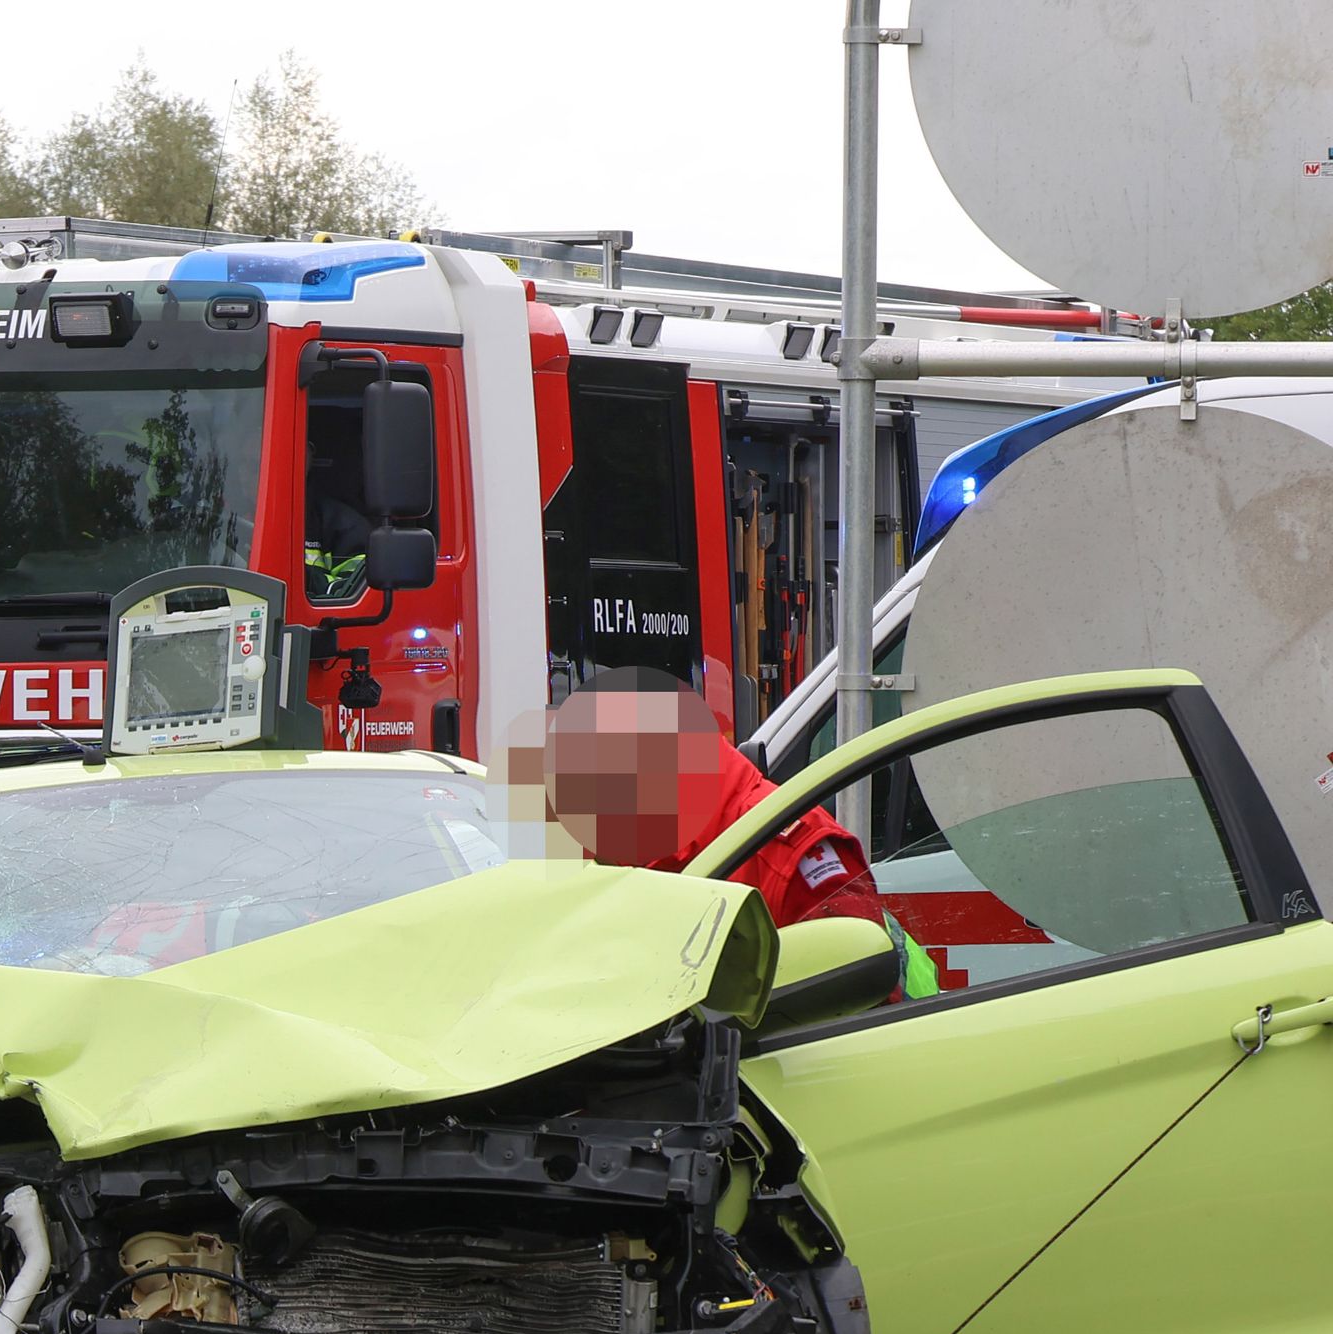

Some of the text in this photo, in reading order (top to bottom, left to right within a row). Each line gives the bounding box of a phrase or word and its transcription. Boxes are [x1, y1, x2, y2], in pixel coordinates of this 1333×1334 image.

[593, 598, 689, 637] RLFA 2000/200
[365, 721, 415, 736] FEUERWEHR
